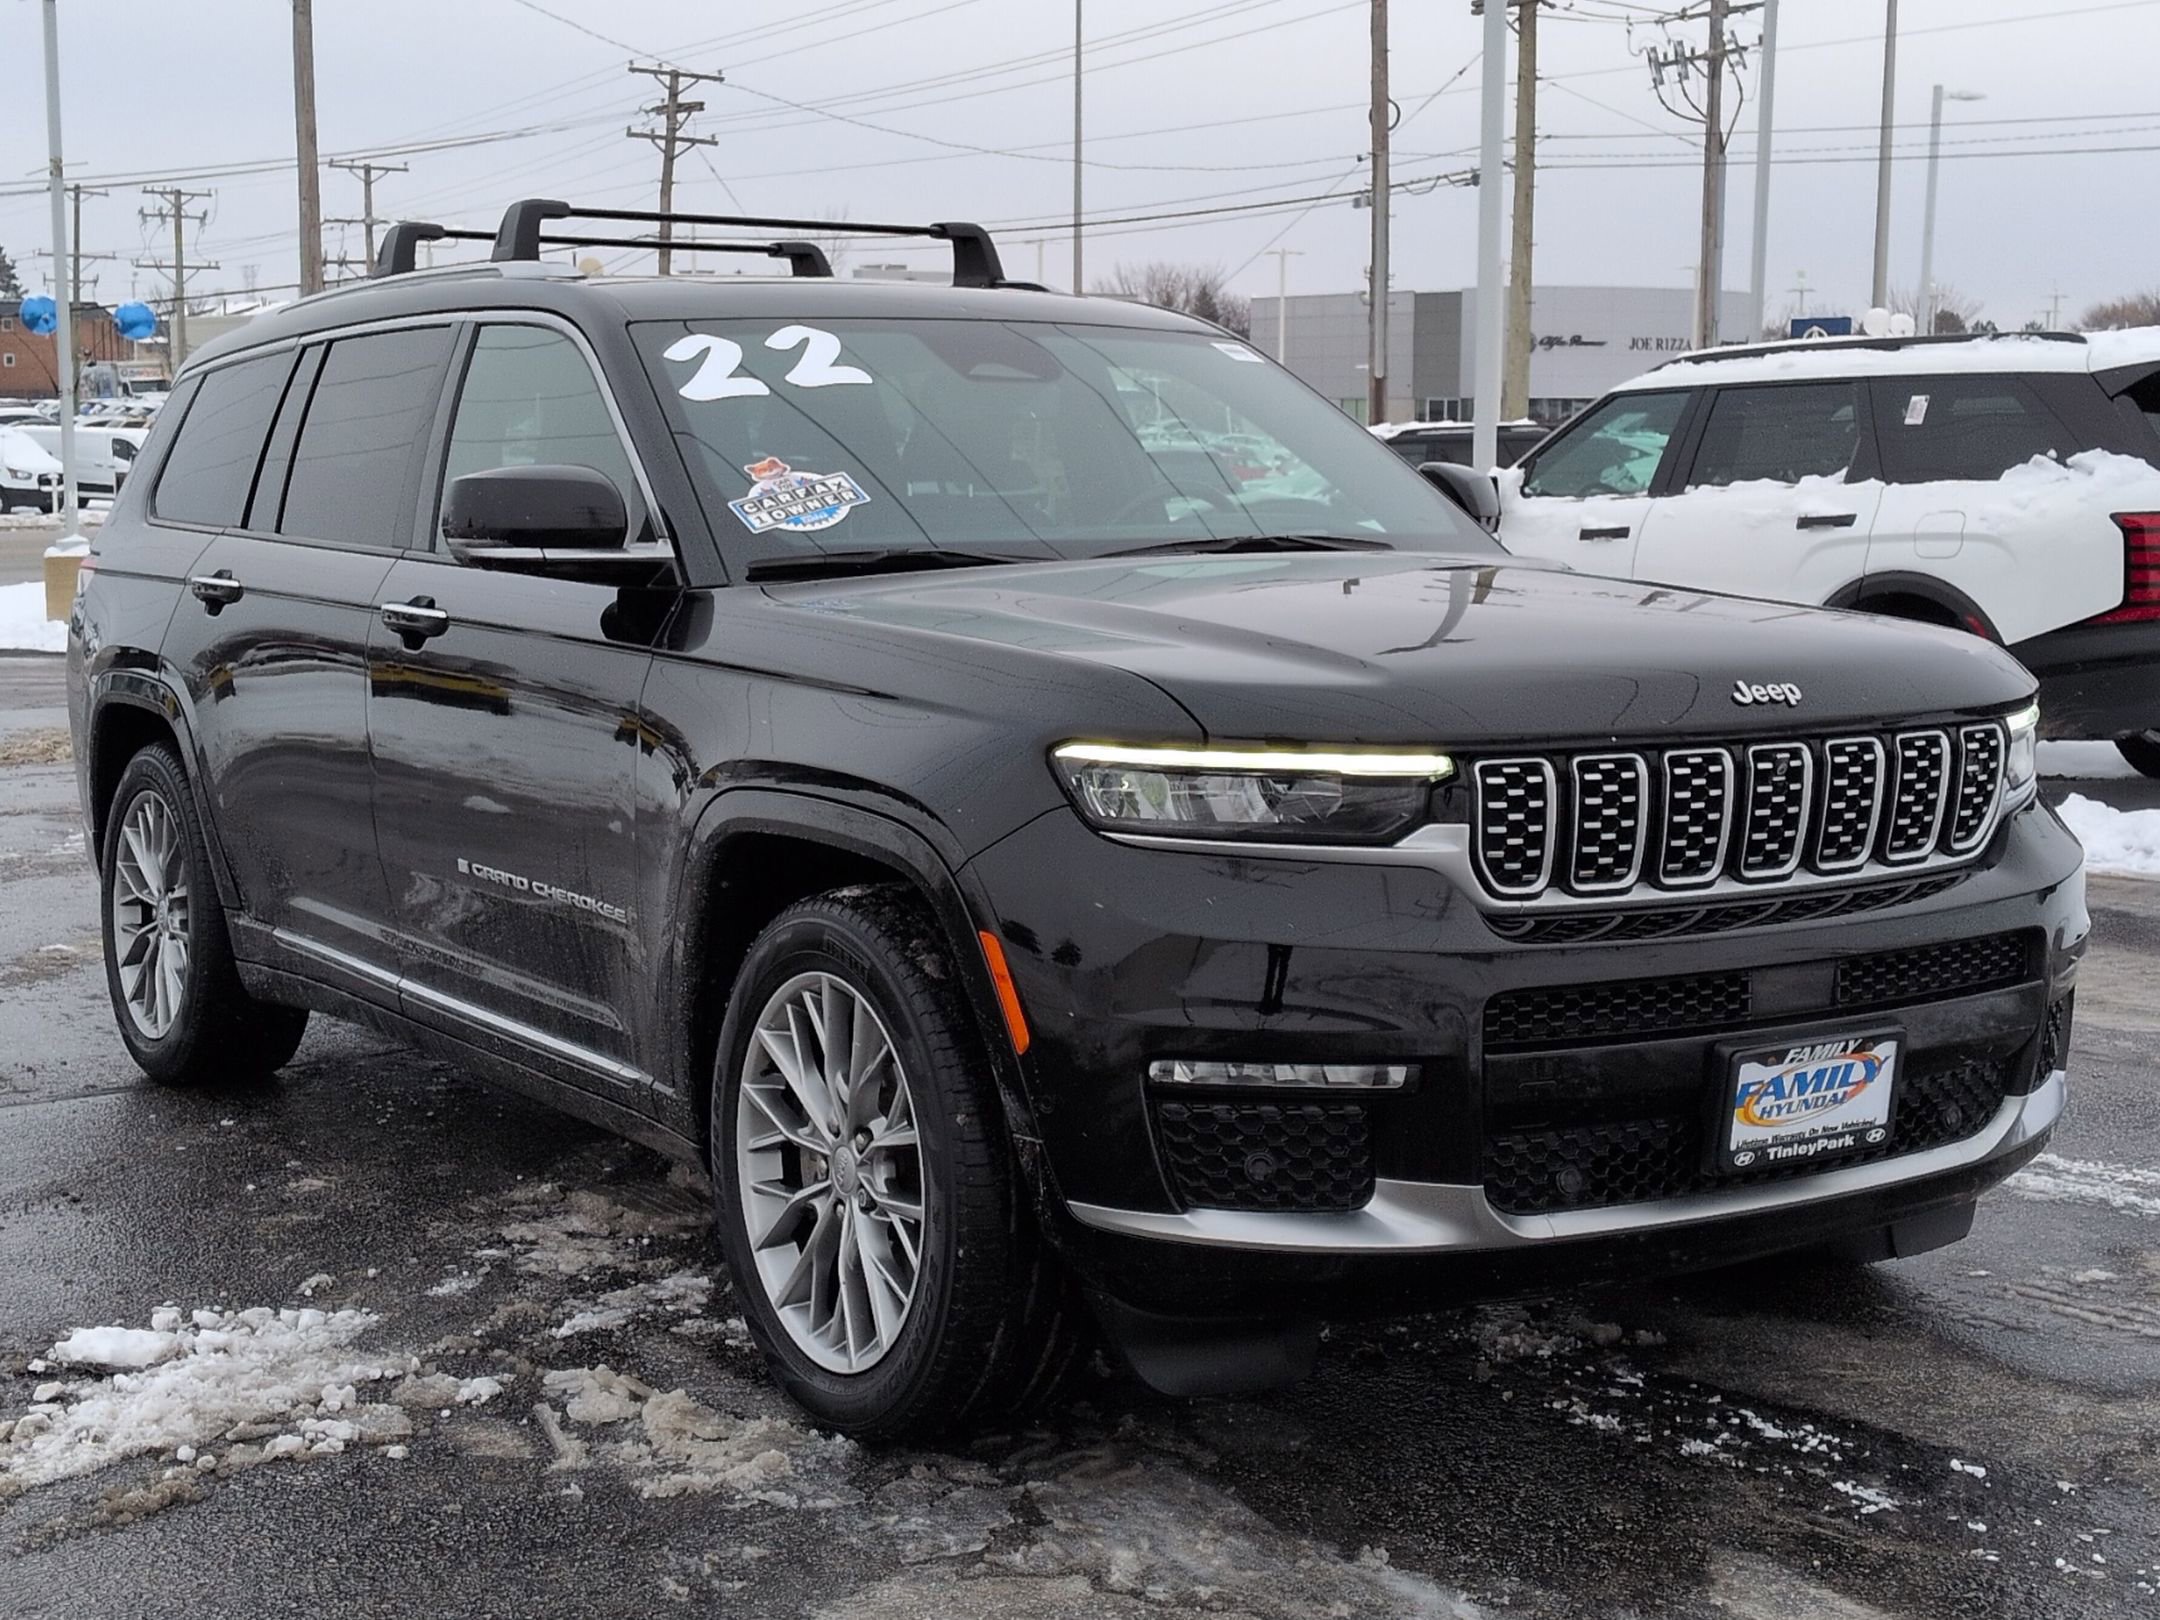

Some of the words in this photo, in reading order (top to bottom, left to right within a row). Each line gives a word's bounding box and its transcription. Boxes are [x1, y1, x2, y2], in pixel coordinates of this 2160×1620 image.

[1628, 337, 1653, 351] JOE
[1655, 337, 1692, 351] RIZZA
[742, 479, 851, 514] CARFAX
[771, 490, 859, 523] OWNER
[1732, 680, 1802, 706] Jeep
[471, 863, 529, 890] GRAND
[532, 880, 627, 924] CHEROKEE
[1783, 1038, 1863, 1065] FAMILY
[1736, 1055, 1891, 1108] FAMILY
[1759, 1091, 1849, 1120] HYUNDAI
[1808, 1127, 1820, 1137] On
